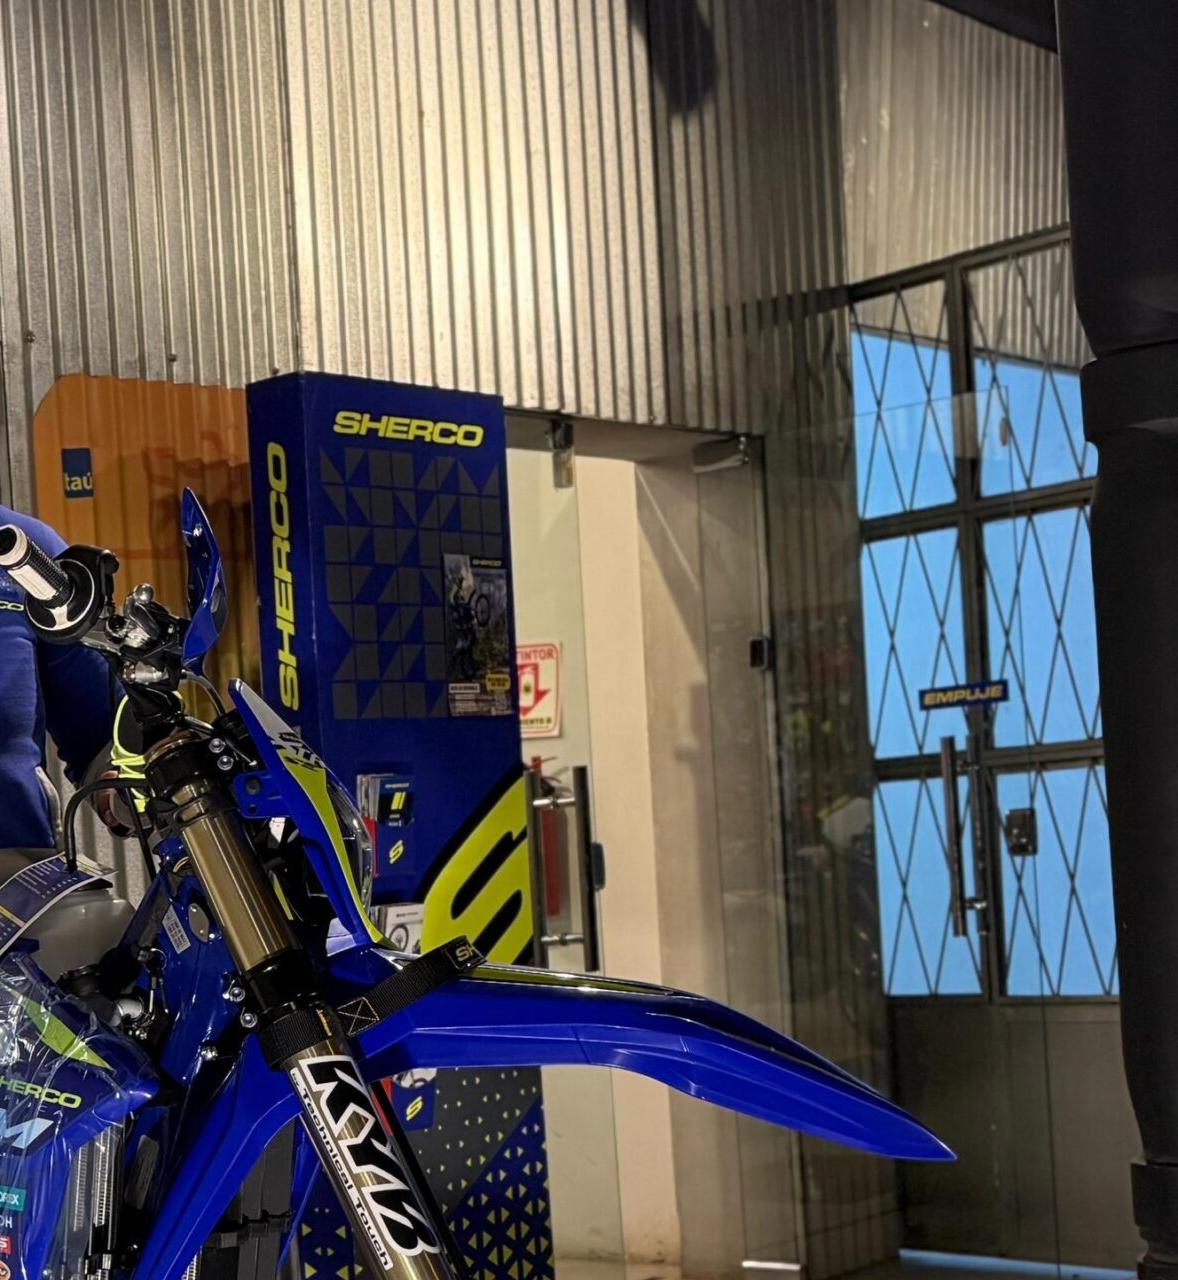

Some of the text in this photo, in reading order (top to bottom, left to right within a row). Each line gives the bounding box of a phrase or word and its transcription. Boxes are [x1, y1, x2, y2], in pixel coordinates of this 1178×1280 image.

[333, 411, 484, 447] SHERCO
[267, 441, 299, 711] SHERCO
[518, 648, 554, 661] INTOR
[924, 684, 1004, 706] EMPUJE
[299, 1056, 440, 1257] KYB
[302, 1088, 354, 1191] Technical
[355, 1198, 390, 1267] Touch
